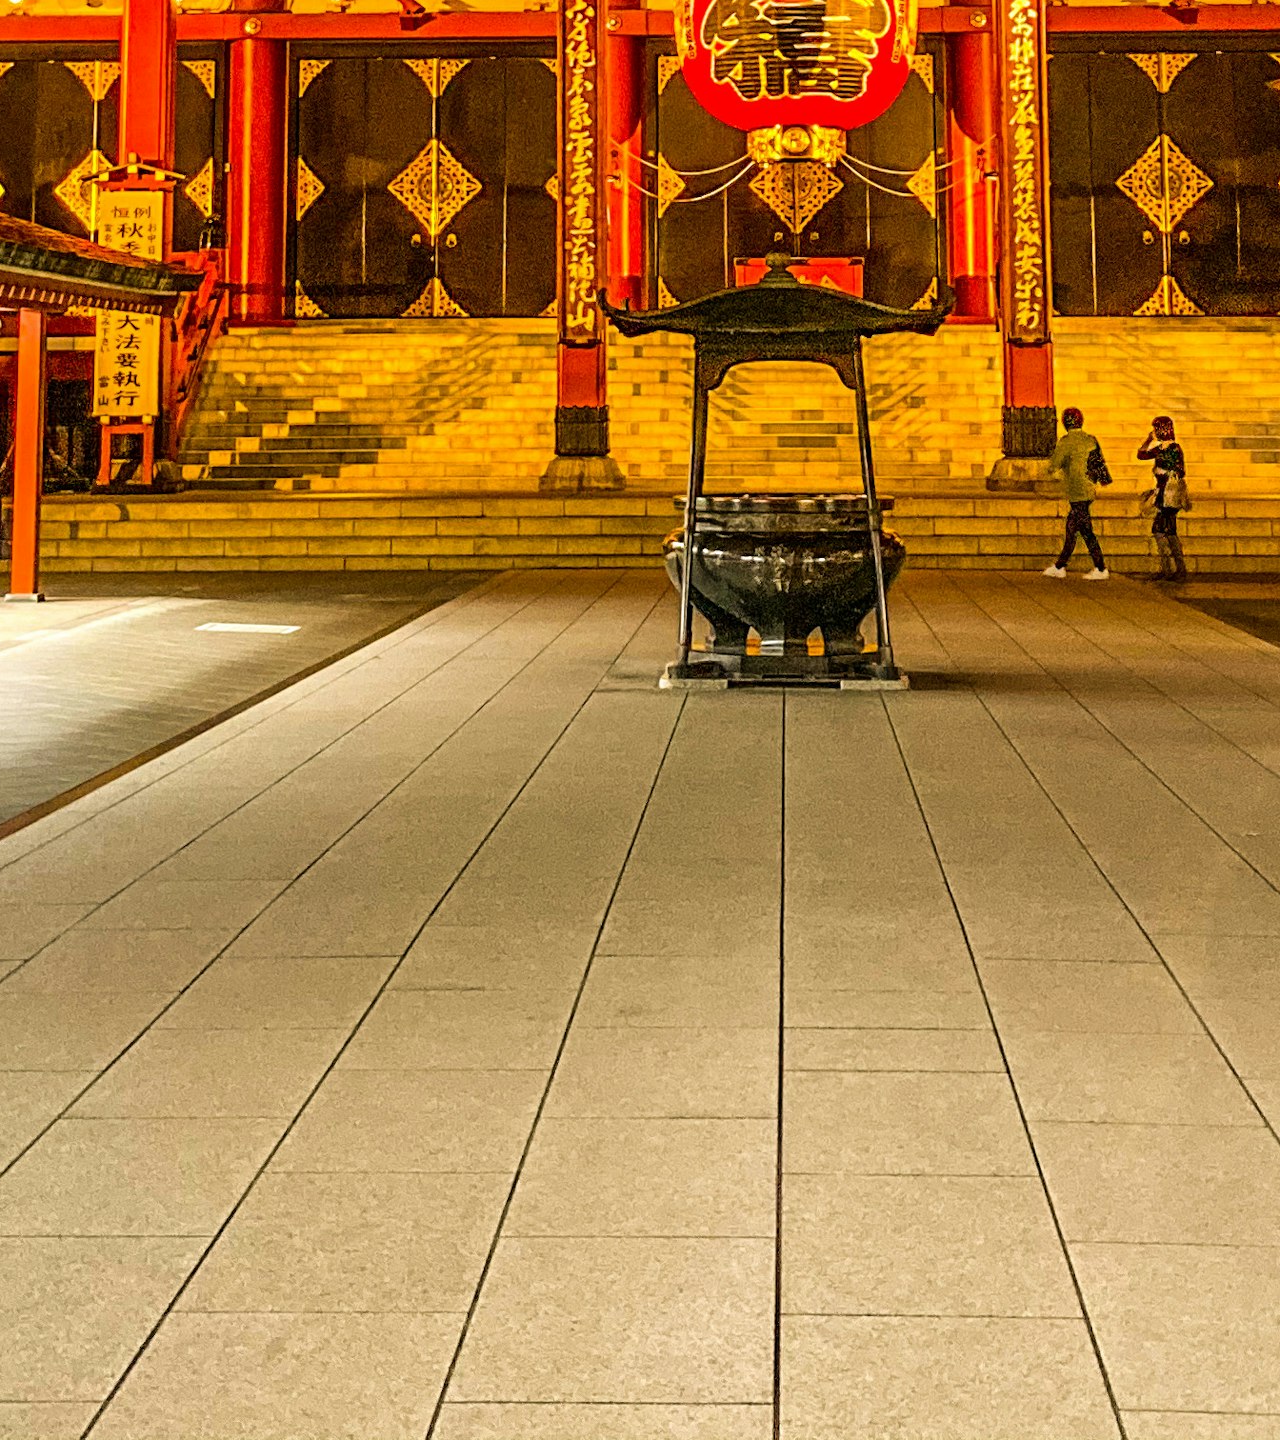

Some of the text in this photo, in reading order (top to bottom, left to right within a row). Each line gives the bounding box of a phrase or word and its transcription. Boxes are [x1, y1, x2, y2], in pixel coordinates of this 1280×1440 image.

[111, 206, 151, 219] 恒例
[113, 315, 141, 406] 大法要執行
